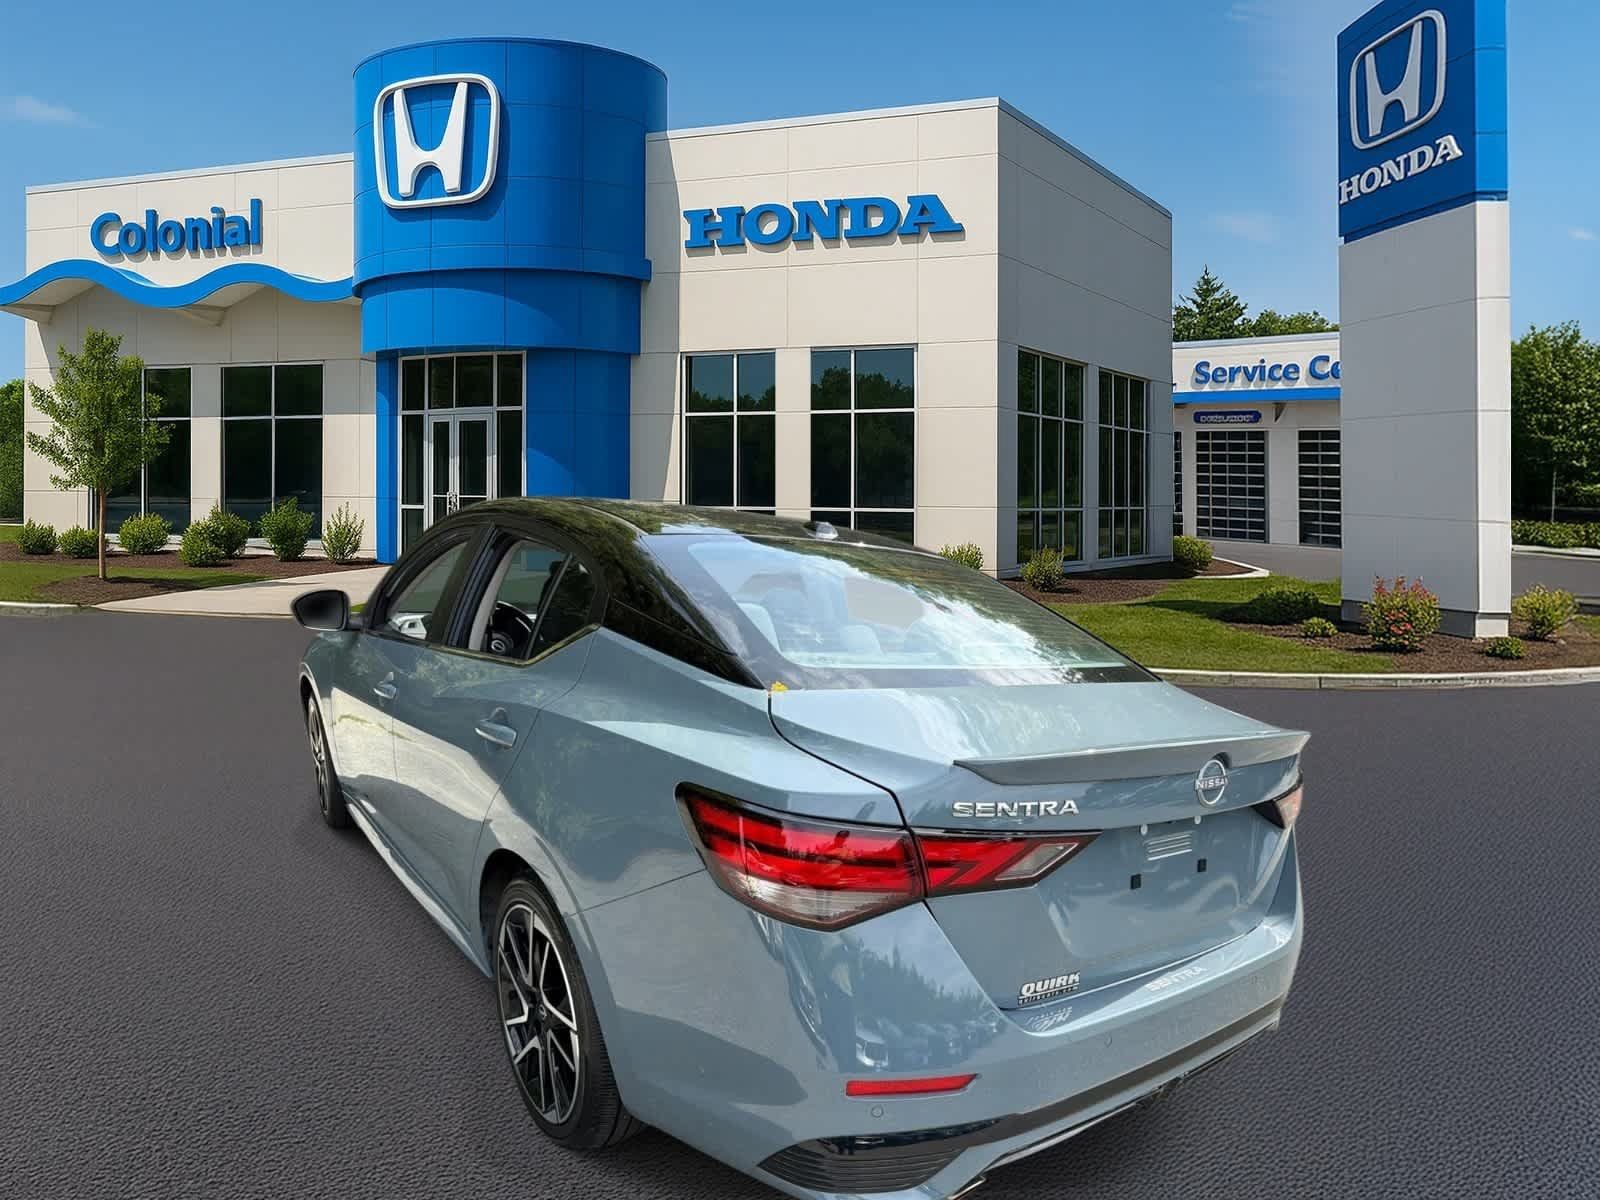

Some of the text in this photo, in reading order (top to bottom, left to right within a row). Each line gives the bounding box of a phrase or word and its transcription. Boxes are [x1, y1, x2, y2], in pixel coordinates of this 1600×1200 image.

[1339, 134, 1463, 205] HONDA
[90, 198, 262, 256] Colonial
[684, 193, 964, 250] HONDA
[1194, 359, 1300, 385] Service
[951, 799, 1080, 818] SENTRA
[1020, 972, 1080, 997] QUIRK
